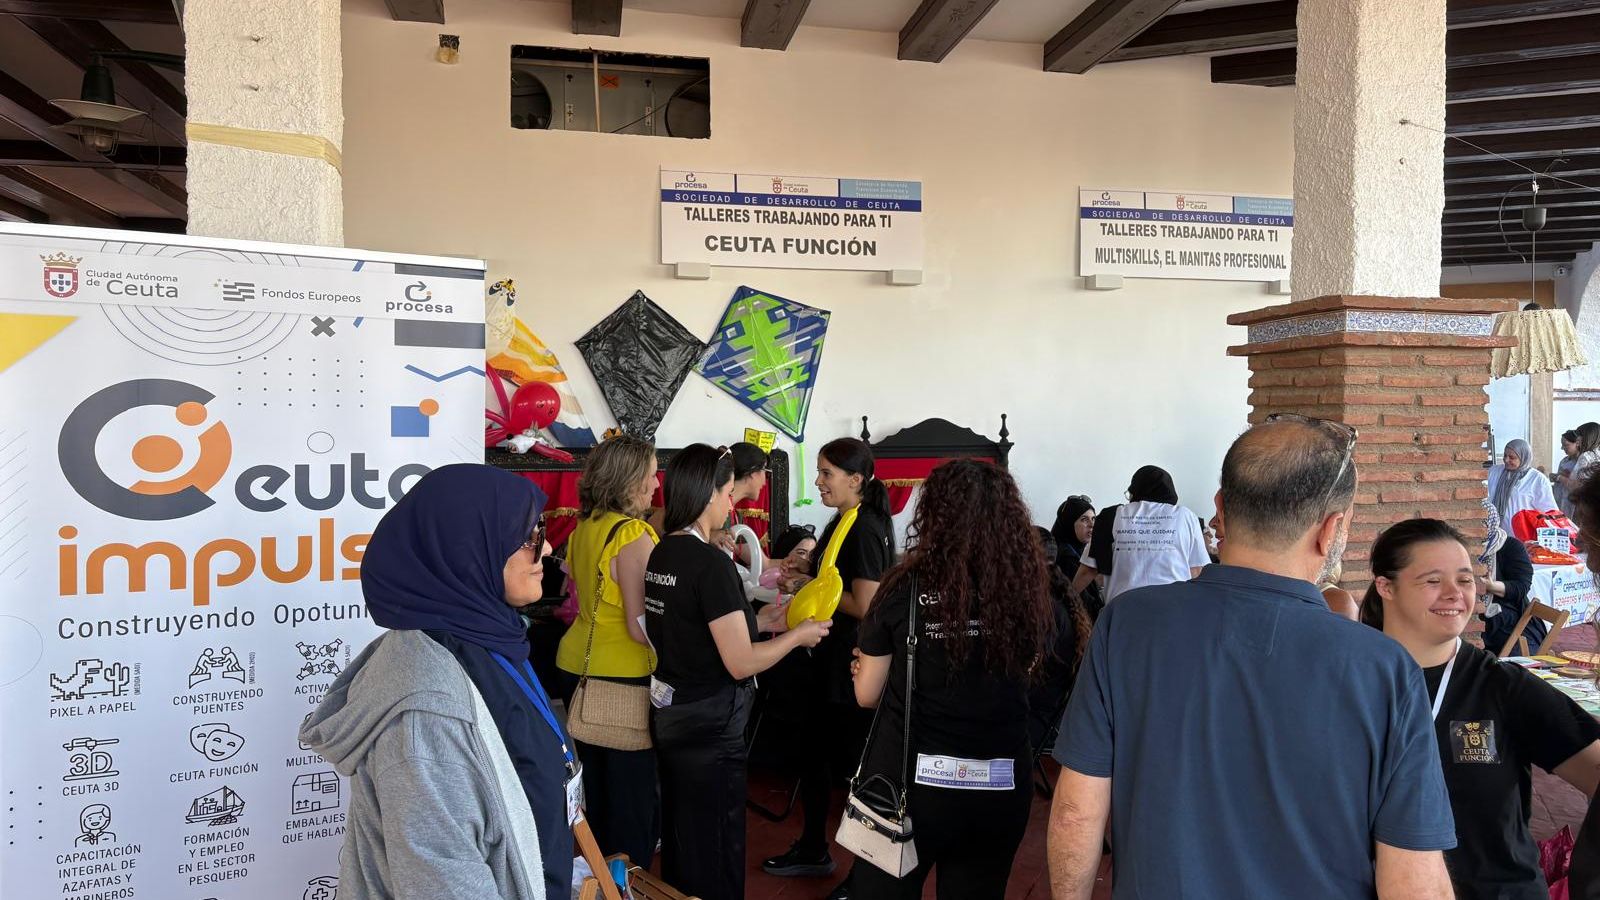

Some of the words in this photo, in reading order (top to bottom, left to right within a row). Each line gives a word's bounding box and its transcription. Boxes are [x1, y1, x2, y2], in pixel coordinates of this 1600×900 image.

[675, 181, 708, 190] procesa
[675, 193, 731, 203] SOCIEDAD
[744, 196, 758, 204] DE
[767, 197, 837, 208] DESARROLLO
[845, 200, 859, 208] DE
[867, 201, 901, 210] CEUTA
[684, 206, 750, 223] TALLERES
[754, 209, 840, 227] TRABAJANDO
[844, 213, 876, 228] PARA
[880, 214, 892, 229] TI
[1092, 210, 1141, 219] SOCIEDAD
[1152, 212, 1164, 220] DE
[1172, 213, 1232, 223] DESARROLLO
[1239, 216, 1250, 224] DE
[1257, 217, 1286, 225] CEUTA
[1100, 222, 1158, 238] TALLERES
[1160, 224, 1235, 241] TRABAJANDO
[1237, 228, 1266, 242] PARA
[1268, 229, 1279, 242] TI
[705, 234, 776, 253] CEUTA
[783, 236, 877, 256] FUNCIÓN
[1095, 247, 1163, 268] MULTISKILLS,
[1165, 250, 1177, 266] EL
[1179, 251, 1221, 267] MANITAS
[1223, 252, 1287, 270] PROFESIONAL
[86, 269, 122, 279] Ciudad
[125, 271, 179, 283] Autónoma
[86, 278, 100, 288] de
[106, 280, 179, 299] Ceuta
[261, 288, 305, 300] Fondos
[308, 291, 362, 304] Europeos
[385, 301, 454, 314] procesa
[58, 606, 256, 640] Construyendo
[173, 688, 264, 706] CONSTRUYENDO
[50, 704, 84, 719] PIXEL
[87, 705, 95, 716] A
[100, 702, 136, 715] PAPEL
[193, 701, 245, 716] PUENTES
[286, 754, 326, 768] MULTIS
[169, 770, 206, 783] CEUTA
[209, 762, 259, 778] FUNCIÓN
[921, 766, 954, 778] procesa
[62, 783, 100, 797] CEUTA
[104, 781, 120, 792] 3D
[286, 812, 347, 830] EMBALAJES
[184, 826, 251, 846] FORMACIÓN
[282, 832, 304, 844] QUE
[56, 843, 142, 865] CAPACITACIÓN
[189, 849, 197, 859] Y
[200, 841, 245, 857] EMPLEO
[58, 862, 118, 879] INTEGRAL
[121, 859, 137, 870] DE
[178, 864, 193, 874] EN
[197, 861, 210, 872] EL
[213, 853, 256, 869] SECTOR
[62, 875, 121, 894] AZAFATAS
[125, 873, 133, 883] Y
[189, 868, 248, 887] PESQUERO
[64, 887, 135, 900] ARINEROS
